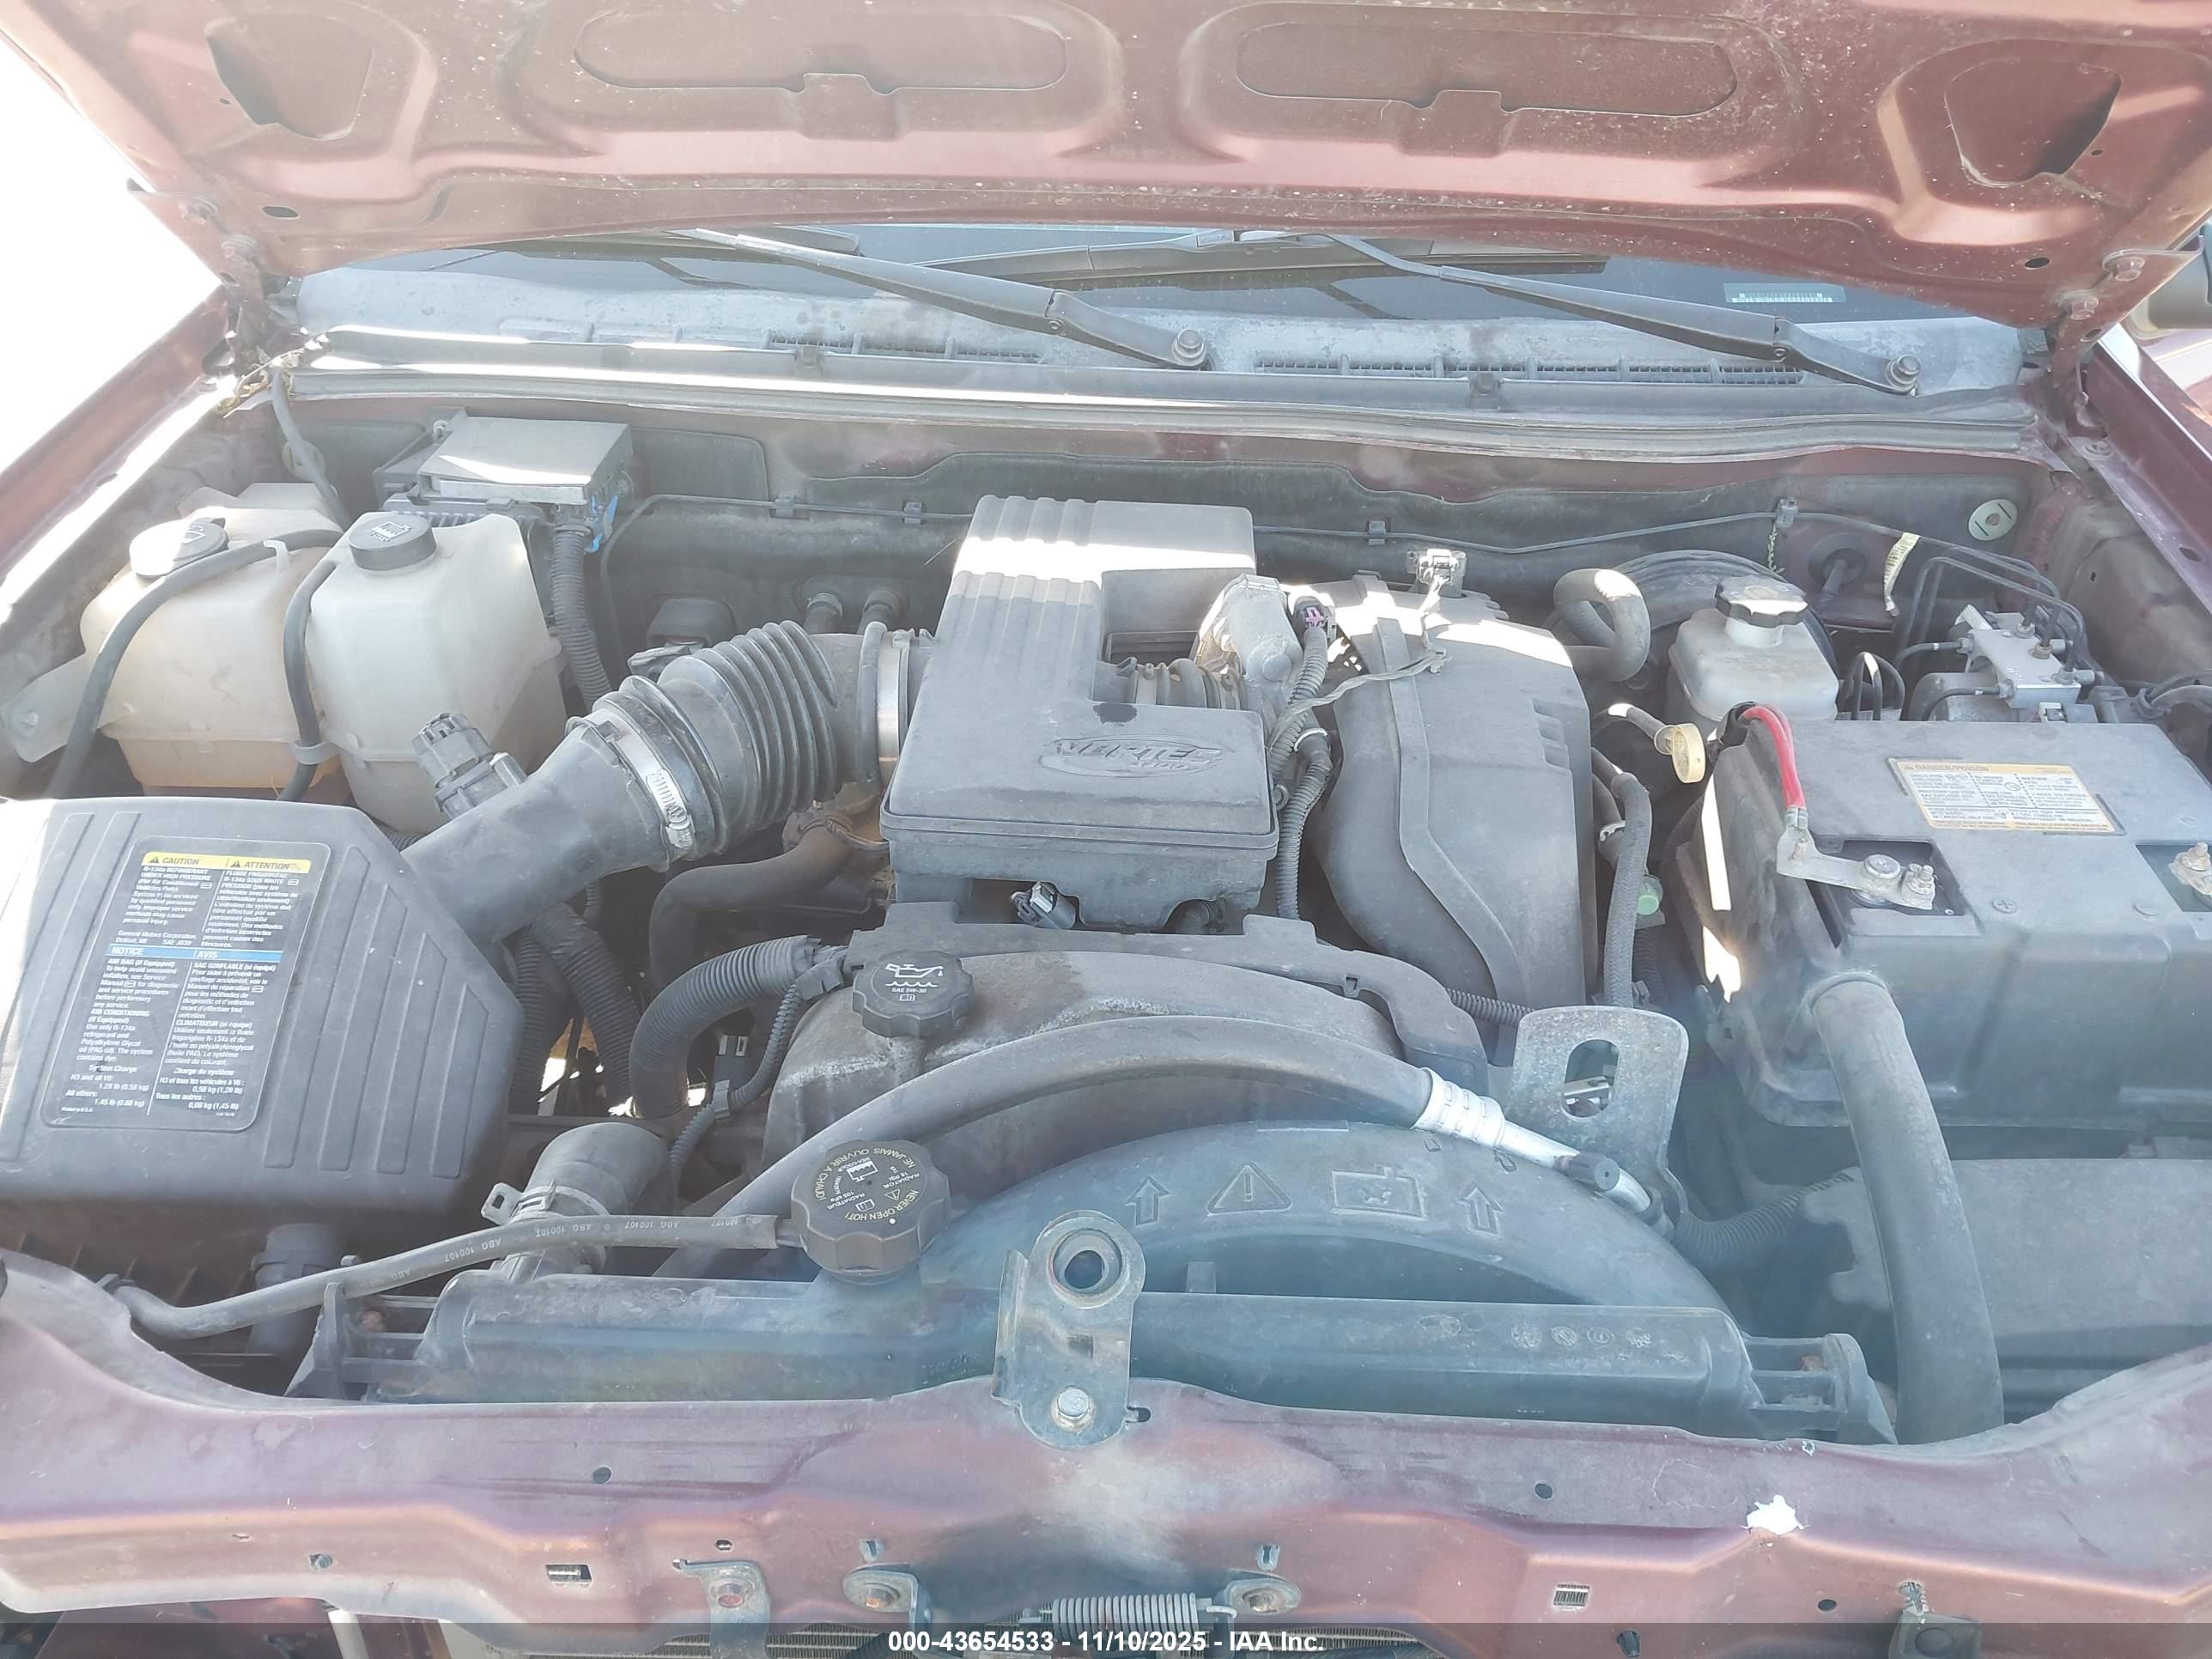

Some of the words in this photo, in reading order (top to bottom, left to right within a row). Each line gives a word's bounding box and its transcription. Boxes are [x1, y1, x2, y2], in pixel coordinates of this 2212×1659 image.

[161, 857, 200, 866] CAUTION
[244, 861, 290, 871] ATTENTION
[830, 1148, 870, 1167] OUVRIR
[873, 1147, 907, 1160] JAMAIS
[882, 1173, 921, 1189] RADIATOR
[826, 1193, 866, 1210] RADIATEUR
[893, 1189, 920, 1211] NEVER
[869, 1208, 896, 1220] OPEN
